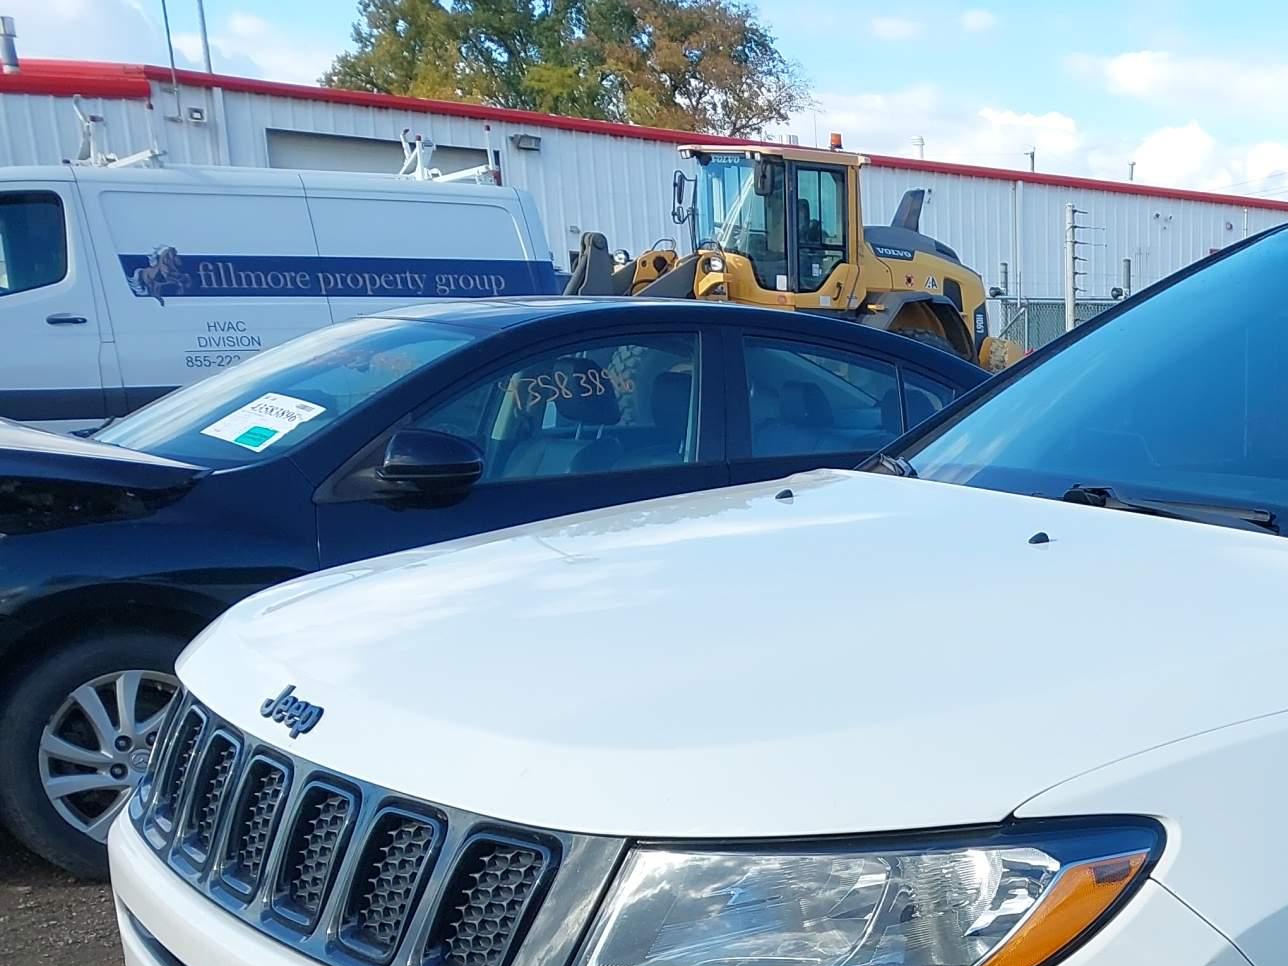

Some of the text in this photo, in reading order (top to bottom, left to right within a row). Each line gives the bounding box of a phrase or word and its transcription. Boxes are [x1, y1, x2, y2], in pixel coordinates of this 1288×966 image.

[710, 154, 740, 164] VOLVO
[876, 247, 912, 258] VOLVO
[197, 261, 506, 297] fillmore property group
[206, 320, 247, 333] HVAC
[197, 336, 262, 348] DIVISION
[260, 684, 324, 740] Jeep
